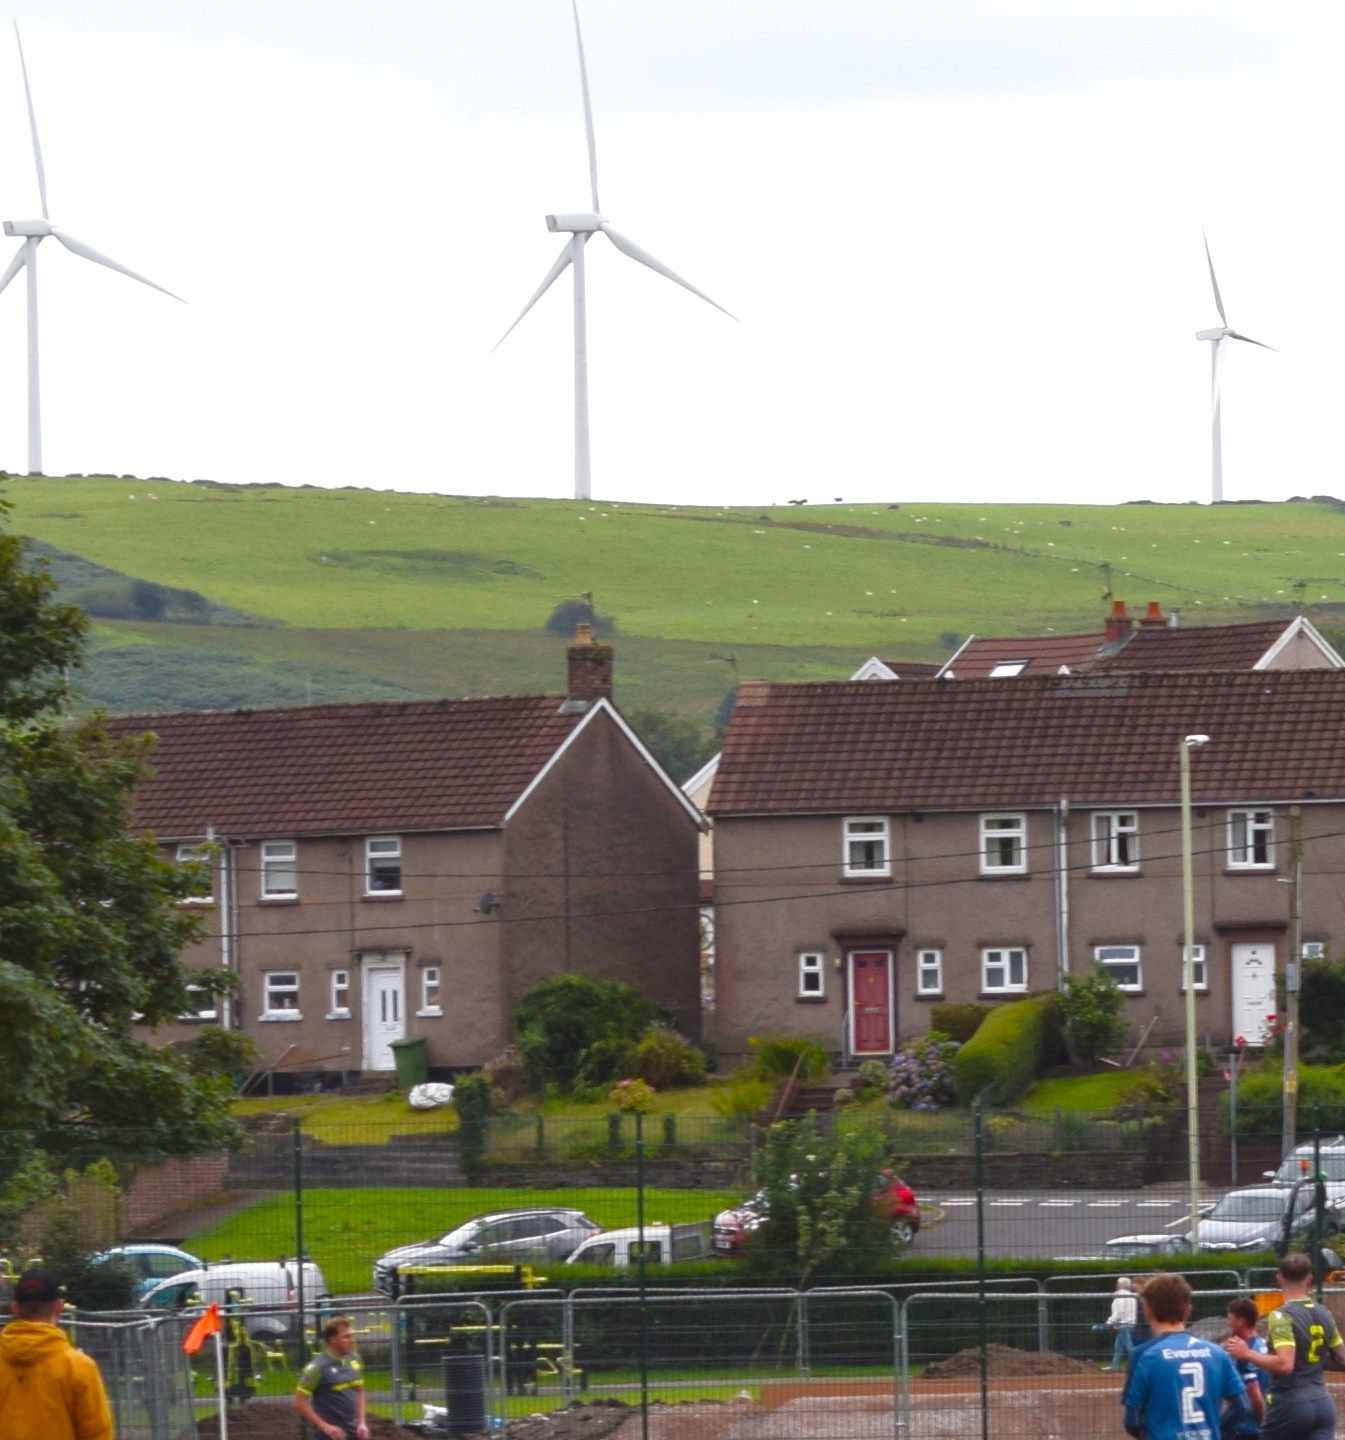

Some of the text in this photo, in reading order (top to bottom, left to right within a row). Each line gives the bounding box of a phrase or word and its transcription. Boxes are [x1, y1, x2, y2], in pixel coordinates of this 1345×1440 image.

[1162, 1347, 1212, 1360] Everest
[1308, 1325, 1324, 1363] 2
[1179, 1362, 1206, 1424] 2
